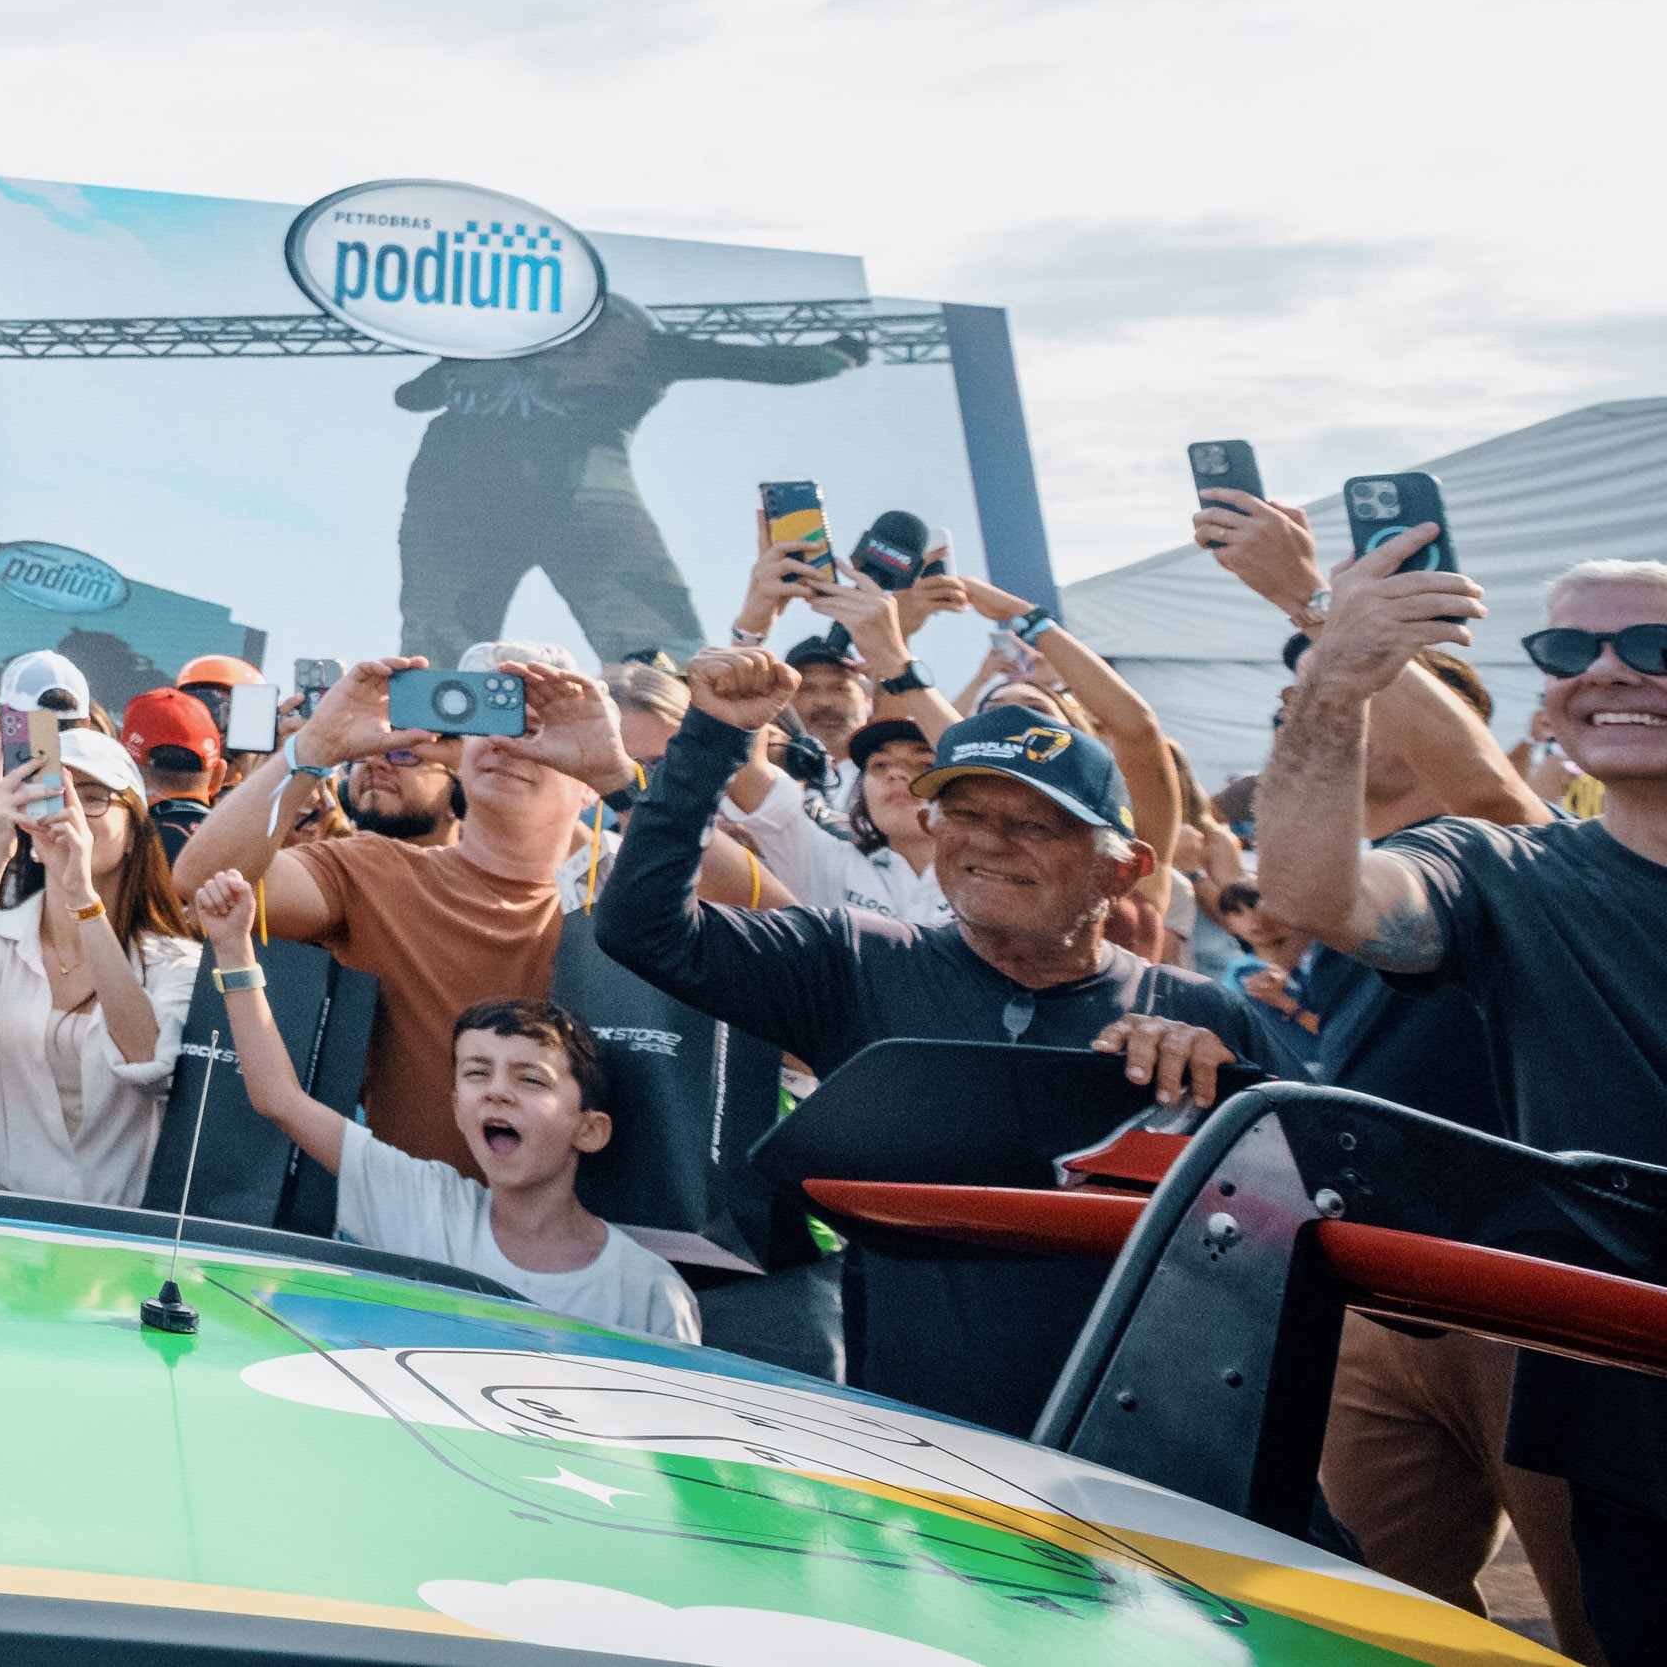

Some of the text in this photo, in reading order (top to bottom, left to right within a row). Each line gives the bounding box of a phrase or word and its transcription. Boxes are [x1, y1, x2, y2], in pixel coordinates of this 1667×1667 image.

[334, 211, 431, 230] PETROBRAS
[334, 227, 563, 313] podium
[1, 558, 113, 602] podium
